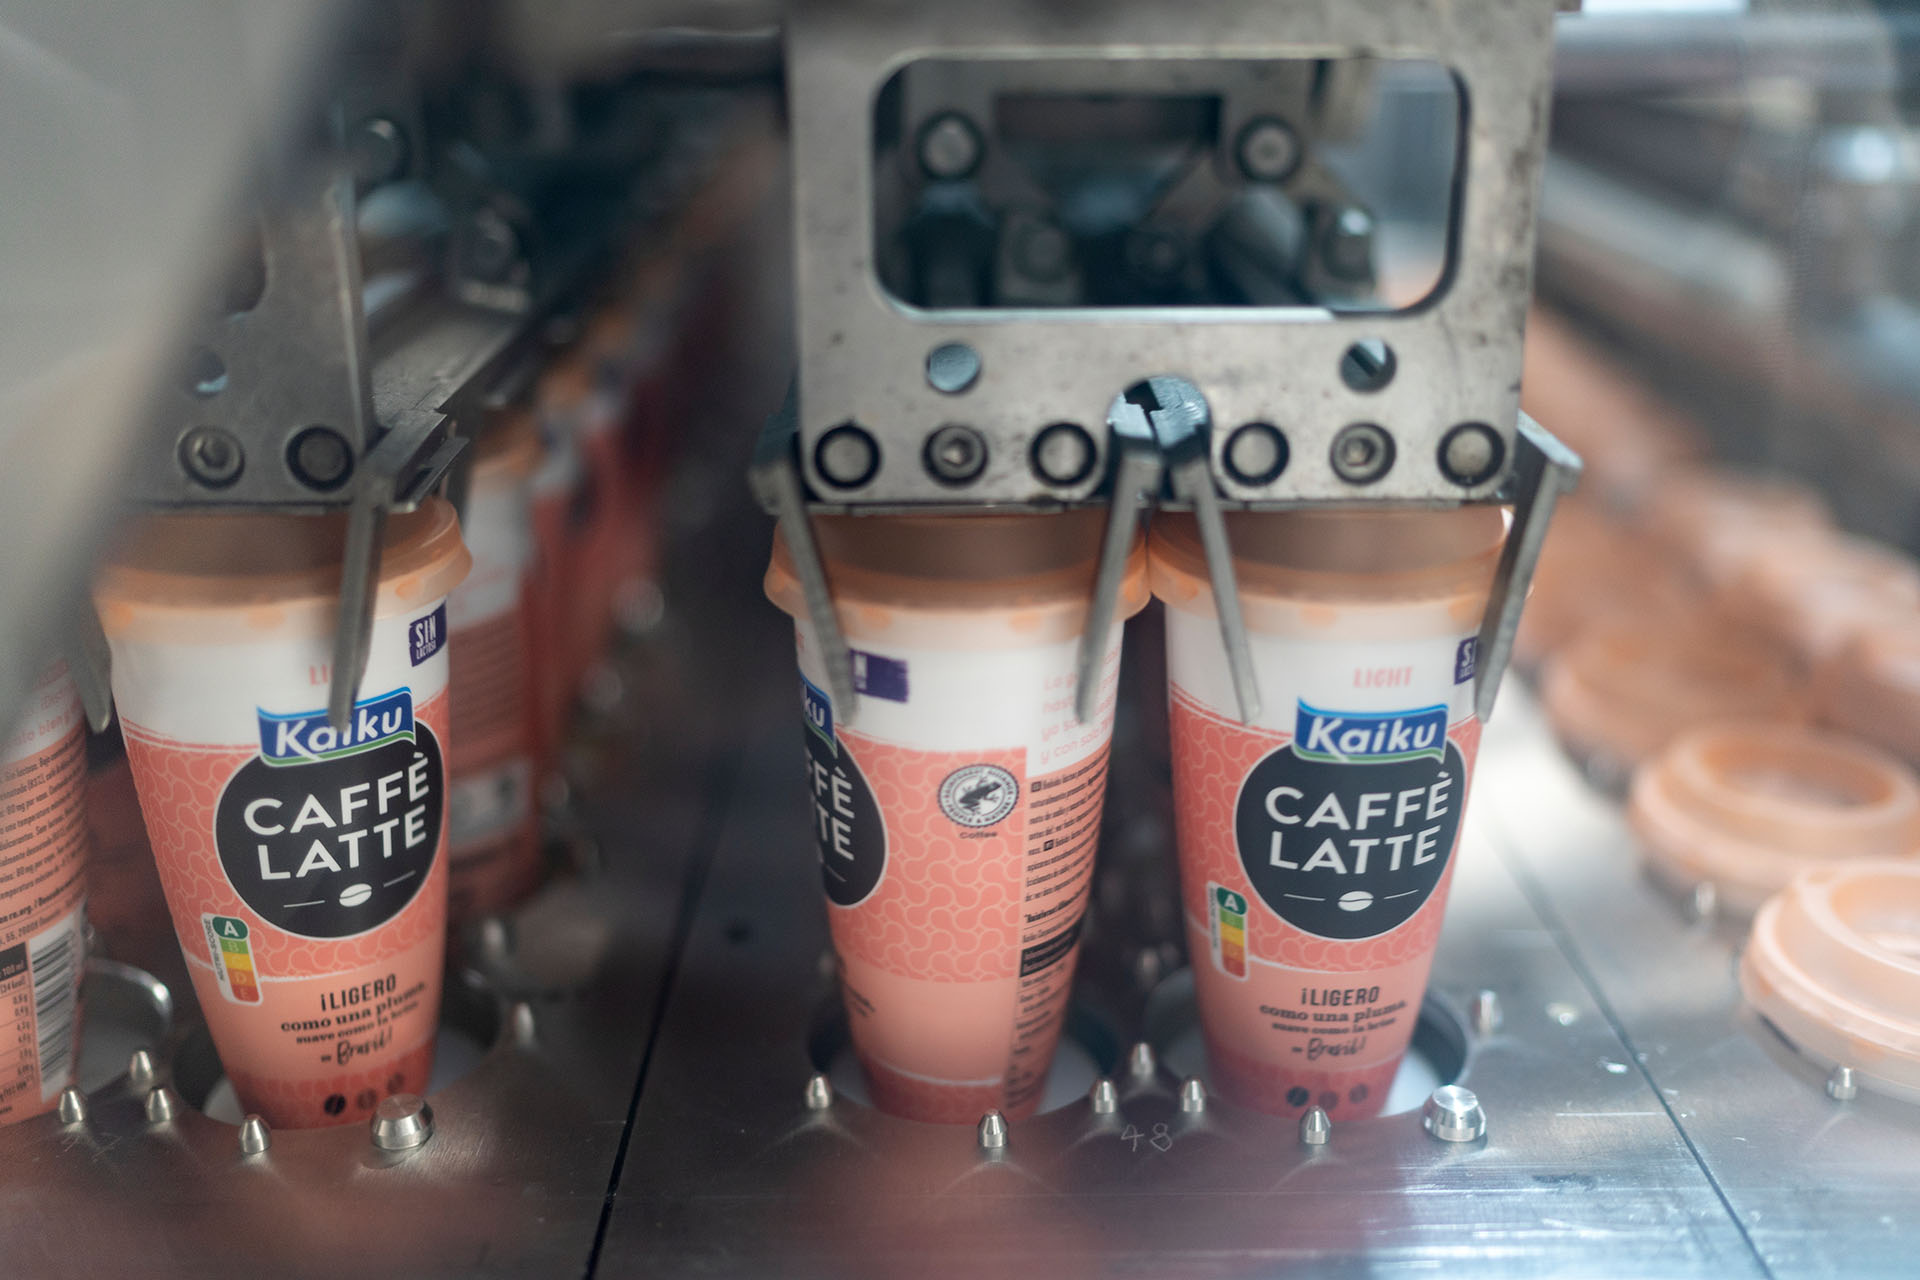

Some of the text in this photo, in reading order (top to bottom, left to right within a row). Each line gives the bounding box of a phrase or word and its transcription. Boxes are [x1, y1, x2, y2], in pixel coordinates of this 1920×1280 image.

[416, 615, 436, 648] SIN
[1353, 666, 1414, 688] LIGHT
[1307, 716, 1437, 762] Kaiku
[244, 752, 429, 835] CAFFÈ
[1265, 771, 1452, 831] CAFFÈ
[257, 804, 427, 880] LATTE
[1269, 825, 1442, 875] LATTE
[1224, 894, 1240, 912] A
[224, 920, 240, 936] A
[281, 1018, 332, 1032] como
[336, 1008, 372, 1025] una
[1260, 1000, 1406, 1023] como una pluma
[1121, 1122, 1173, 1152] 48
